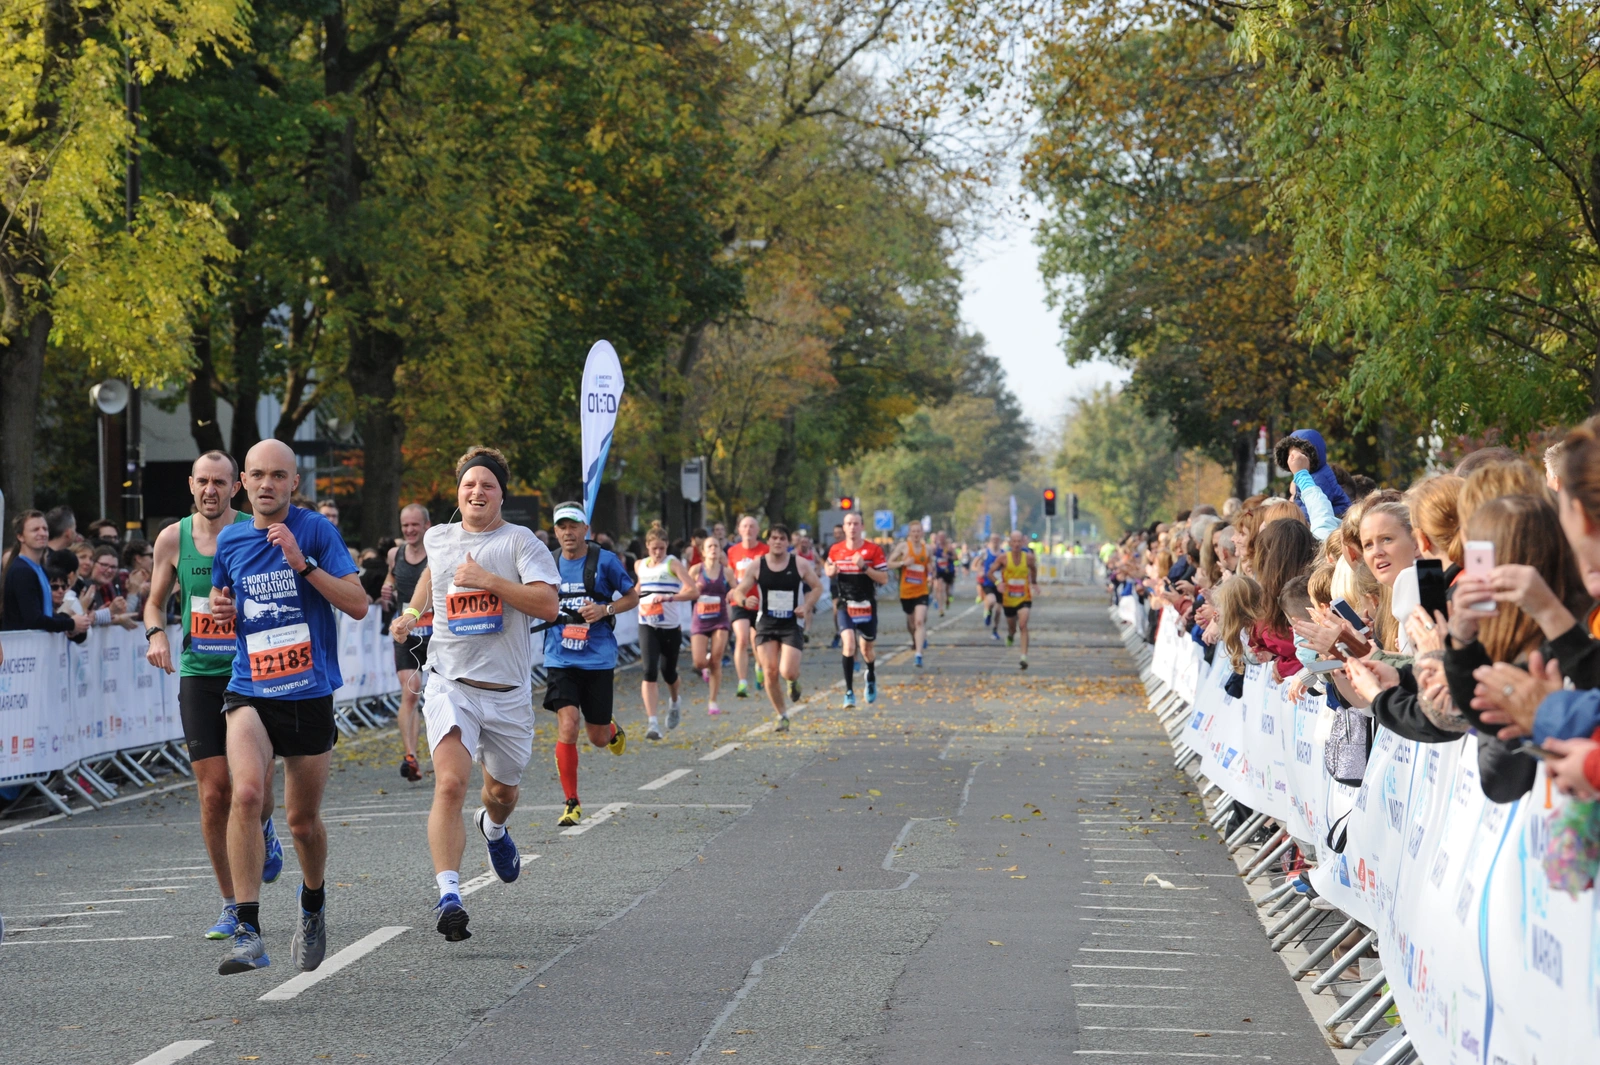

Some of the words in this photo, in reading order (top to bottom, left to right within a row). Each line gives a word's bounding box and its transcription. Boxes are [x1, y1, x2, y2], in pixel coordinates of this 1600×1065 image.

[192, 567, 212, 576] LOST
[247, 573, 269, 585] NORTH
[270, 569, 294, 581] DEVON
[248, 578, 297, 596] MARATHON
[260, 593, 271, 601] HALF
[272, 590, 298, 599] MARATHON
[450, 593, 499, 615] 12069
[272, 630, 298, 638] MANCHESTER
[455, 623, 496, 632] #NOWWERUN
[273, 637, 296, 645] MARATHON
[255, 646, 310, 676] 12185
[262, 679, 309, 694] #NOWWERUN
